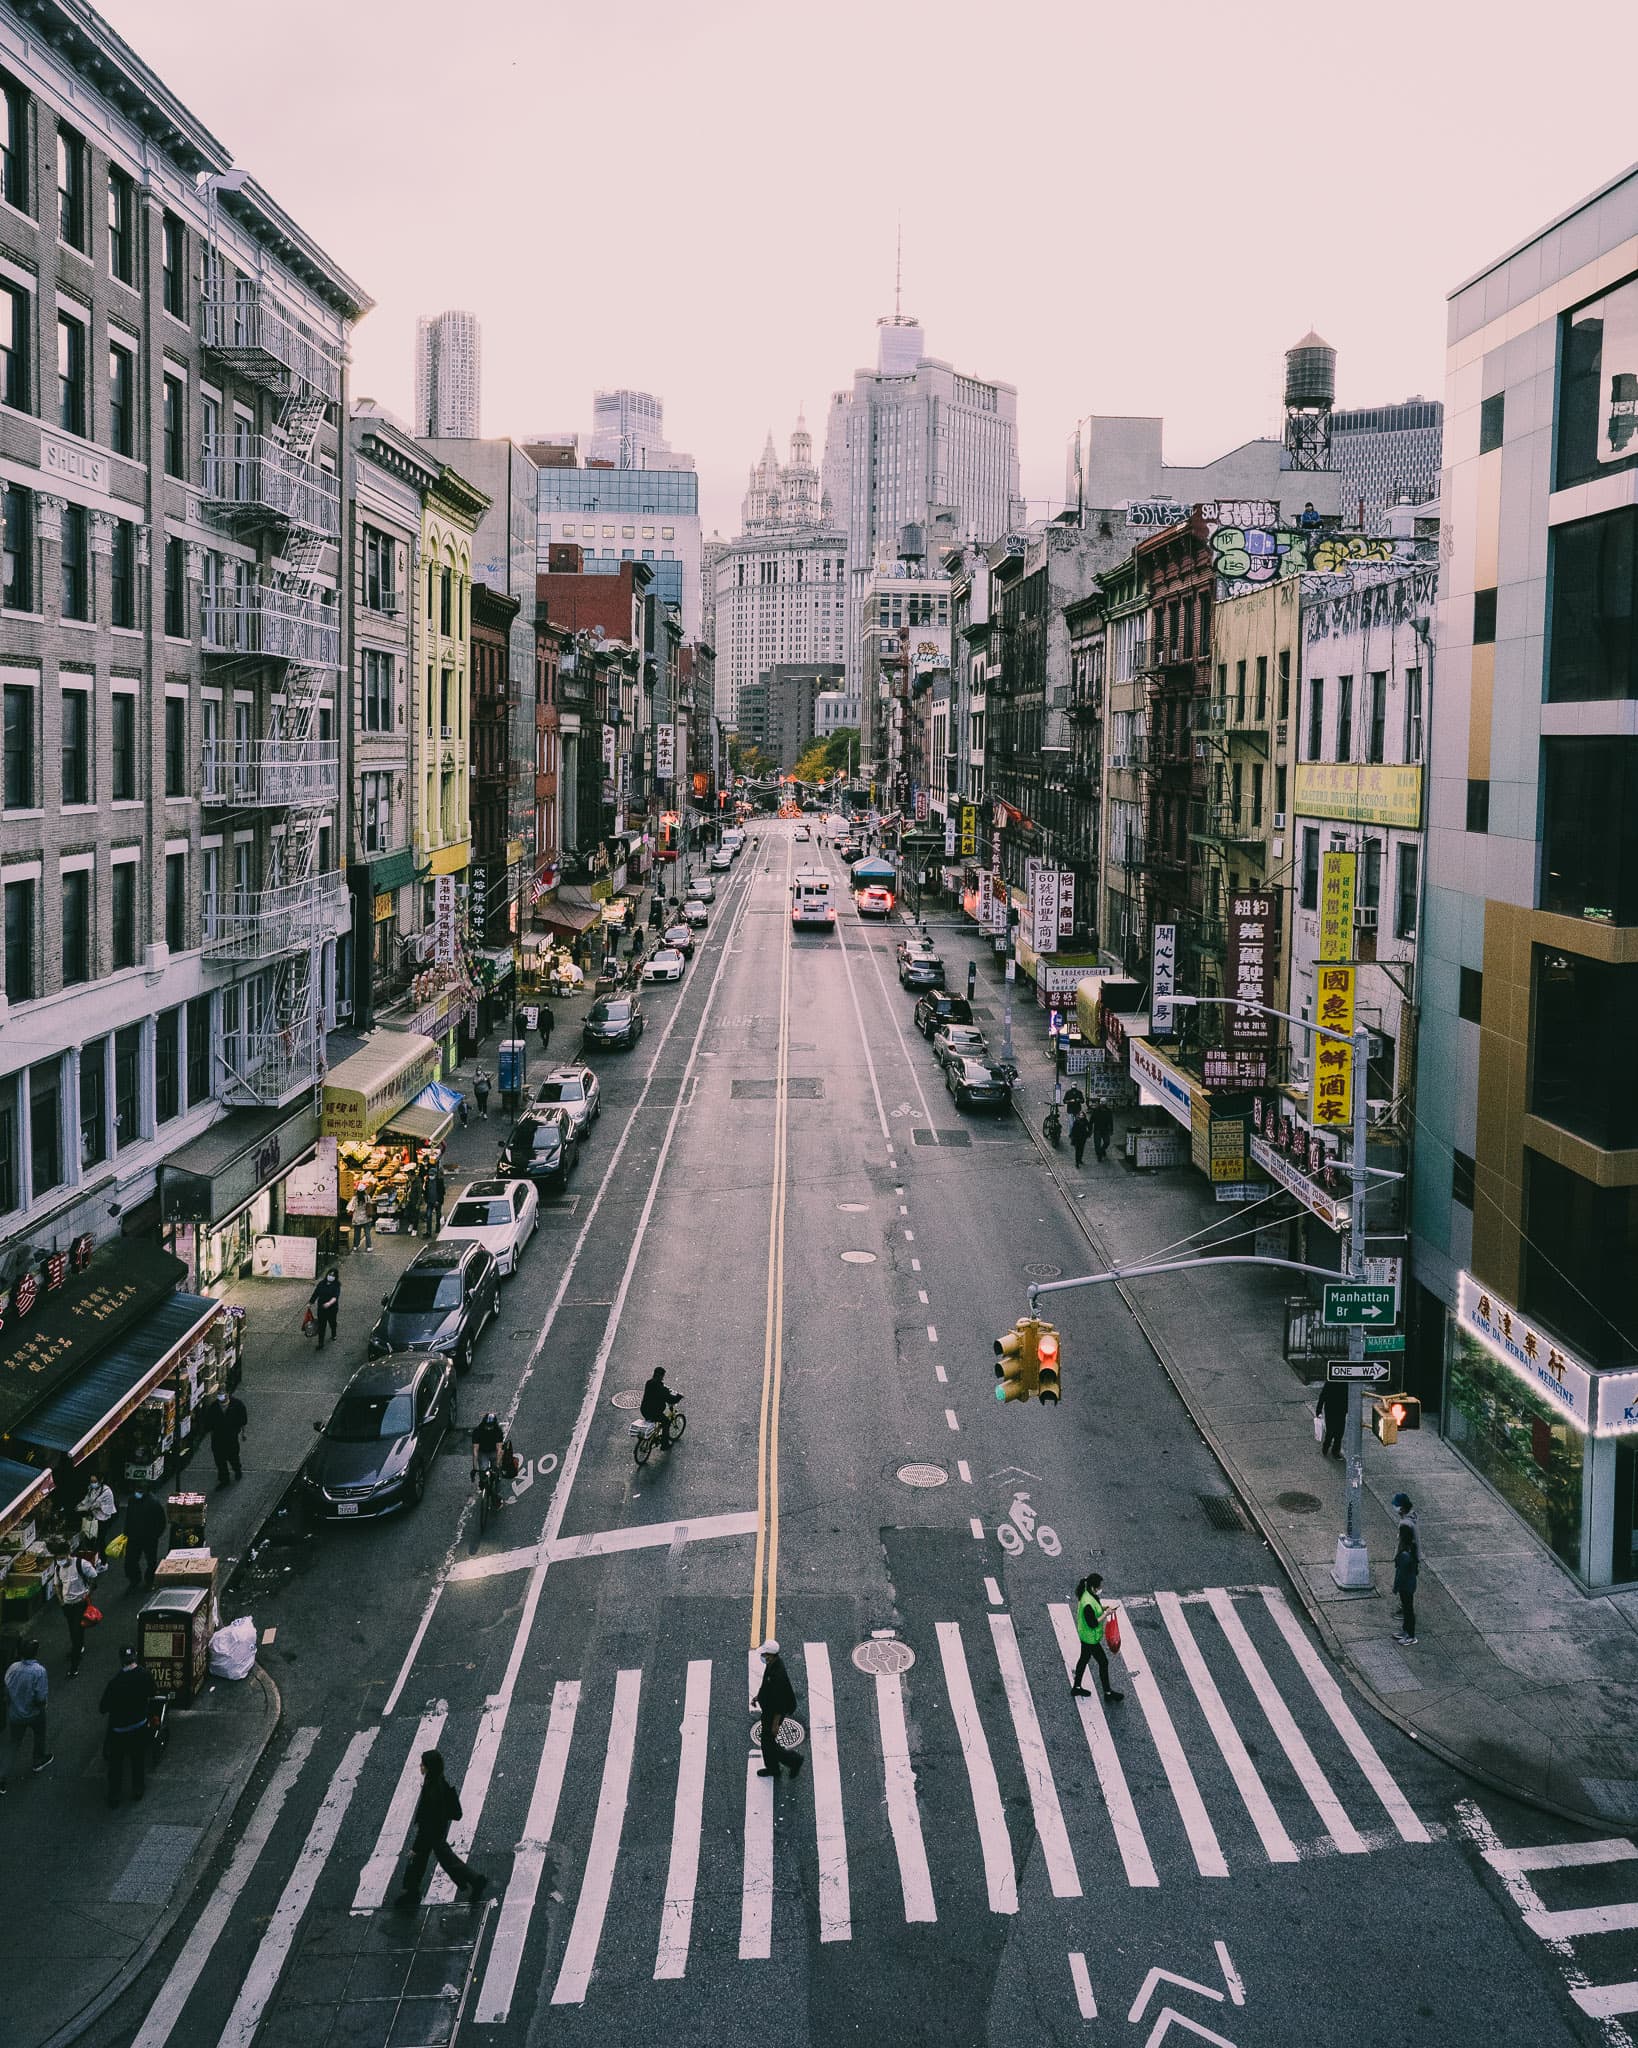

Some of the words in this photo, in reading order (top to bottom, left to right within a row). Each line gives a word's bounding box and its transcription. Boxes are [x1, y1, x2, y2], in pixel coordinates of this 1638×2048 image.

[48, 446, 99, 483] SHEILS
[1234, 899, 1269, 916] 紐約
[1331, 1292, 1390, 1303] Manhattan
[1336, 1307, 1348, 1317] Br
[1368, 1337, 1397, 1346] MARKET
[1471, 1310, 1490, 1333] KANG
[1492, 1327, 1500, 1343] DA
[1505, 1339, 1533, 1371] HERBAL
[1537, 1366, 1574, 1407] MEDICINE
[1334, 1366, 1353, 1376] ONE
[1362, 1366, 1382, 1376] WAY
